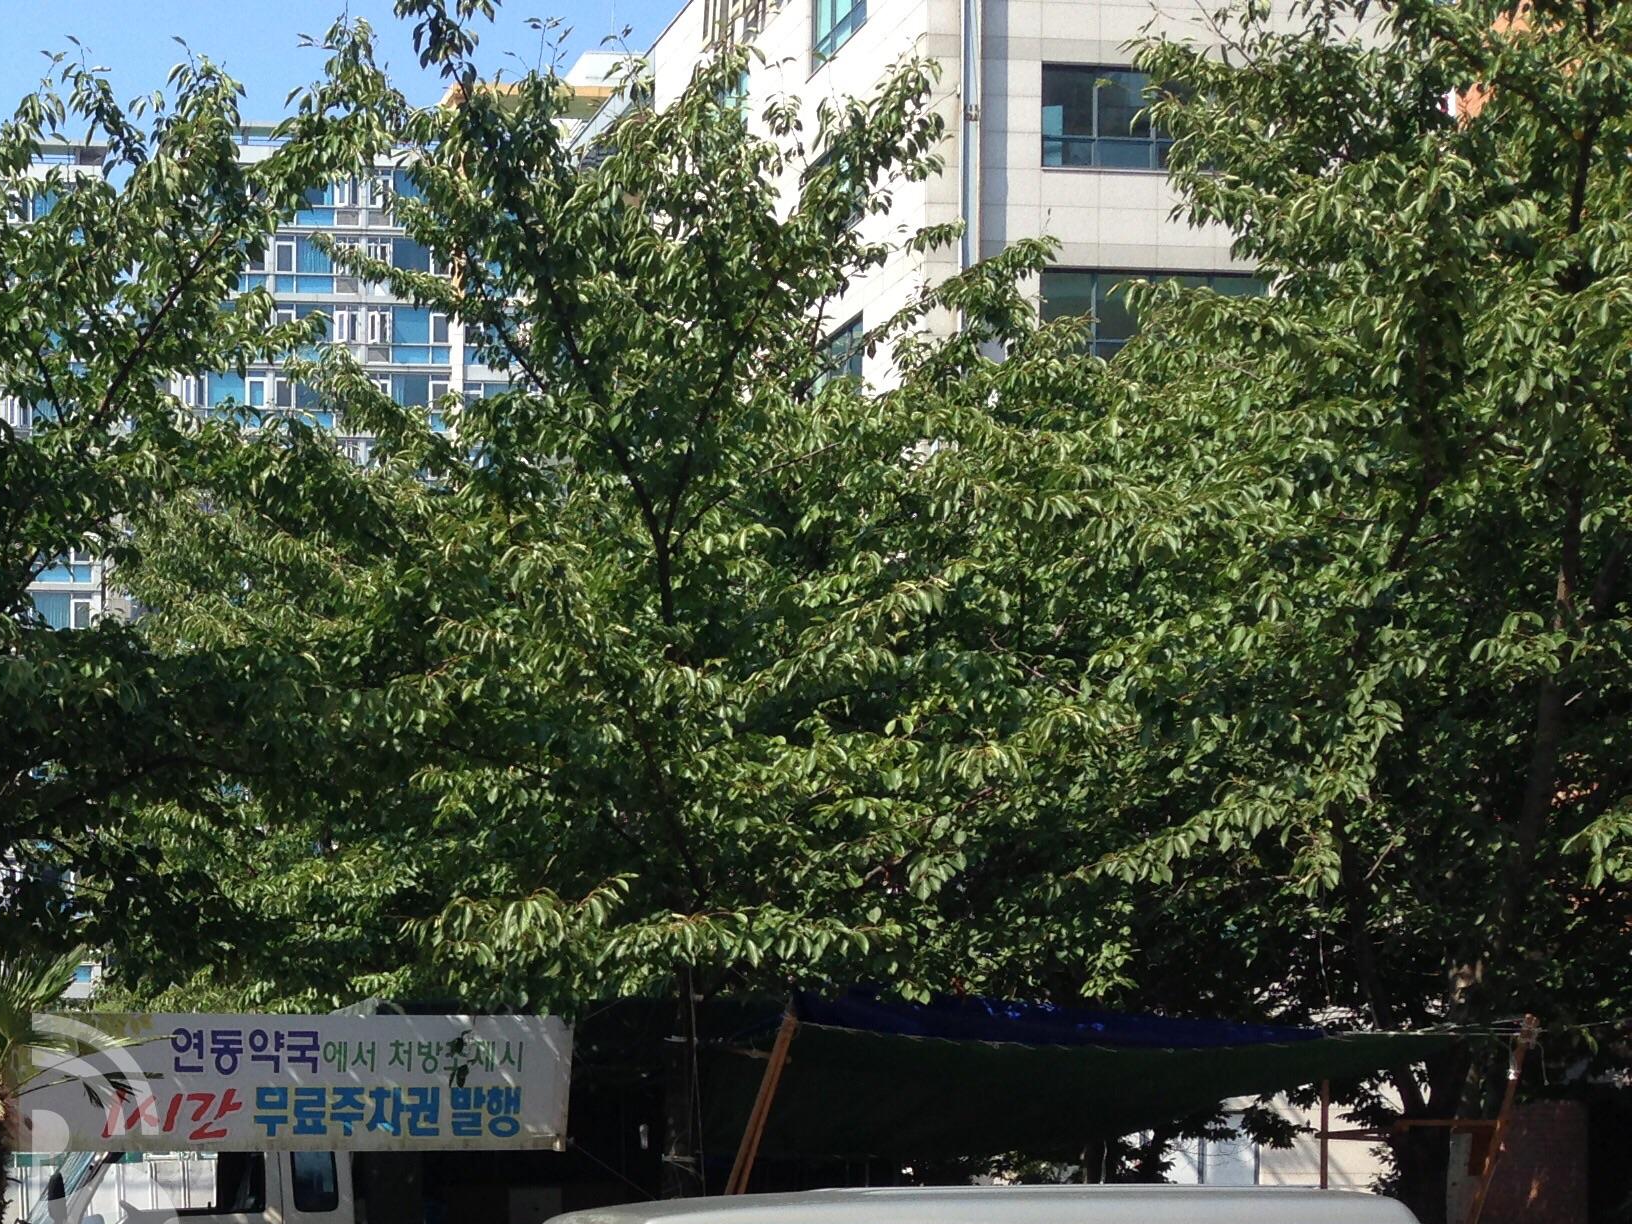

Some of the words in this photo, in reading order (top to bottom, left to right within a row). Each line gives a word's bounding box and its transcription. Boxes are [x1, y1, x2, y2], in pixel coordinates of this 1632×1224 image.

[170, 1027, 376, 1076] 연동약국에서
[101, 1087, 243, 1141] 1시간
[253, 1086, 440, 1138] 무료주차권
[450, 1086, 522, 1138] 발행
